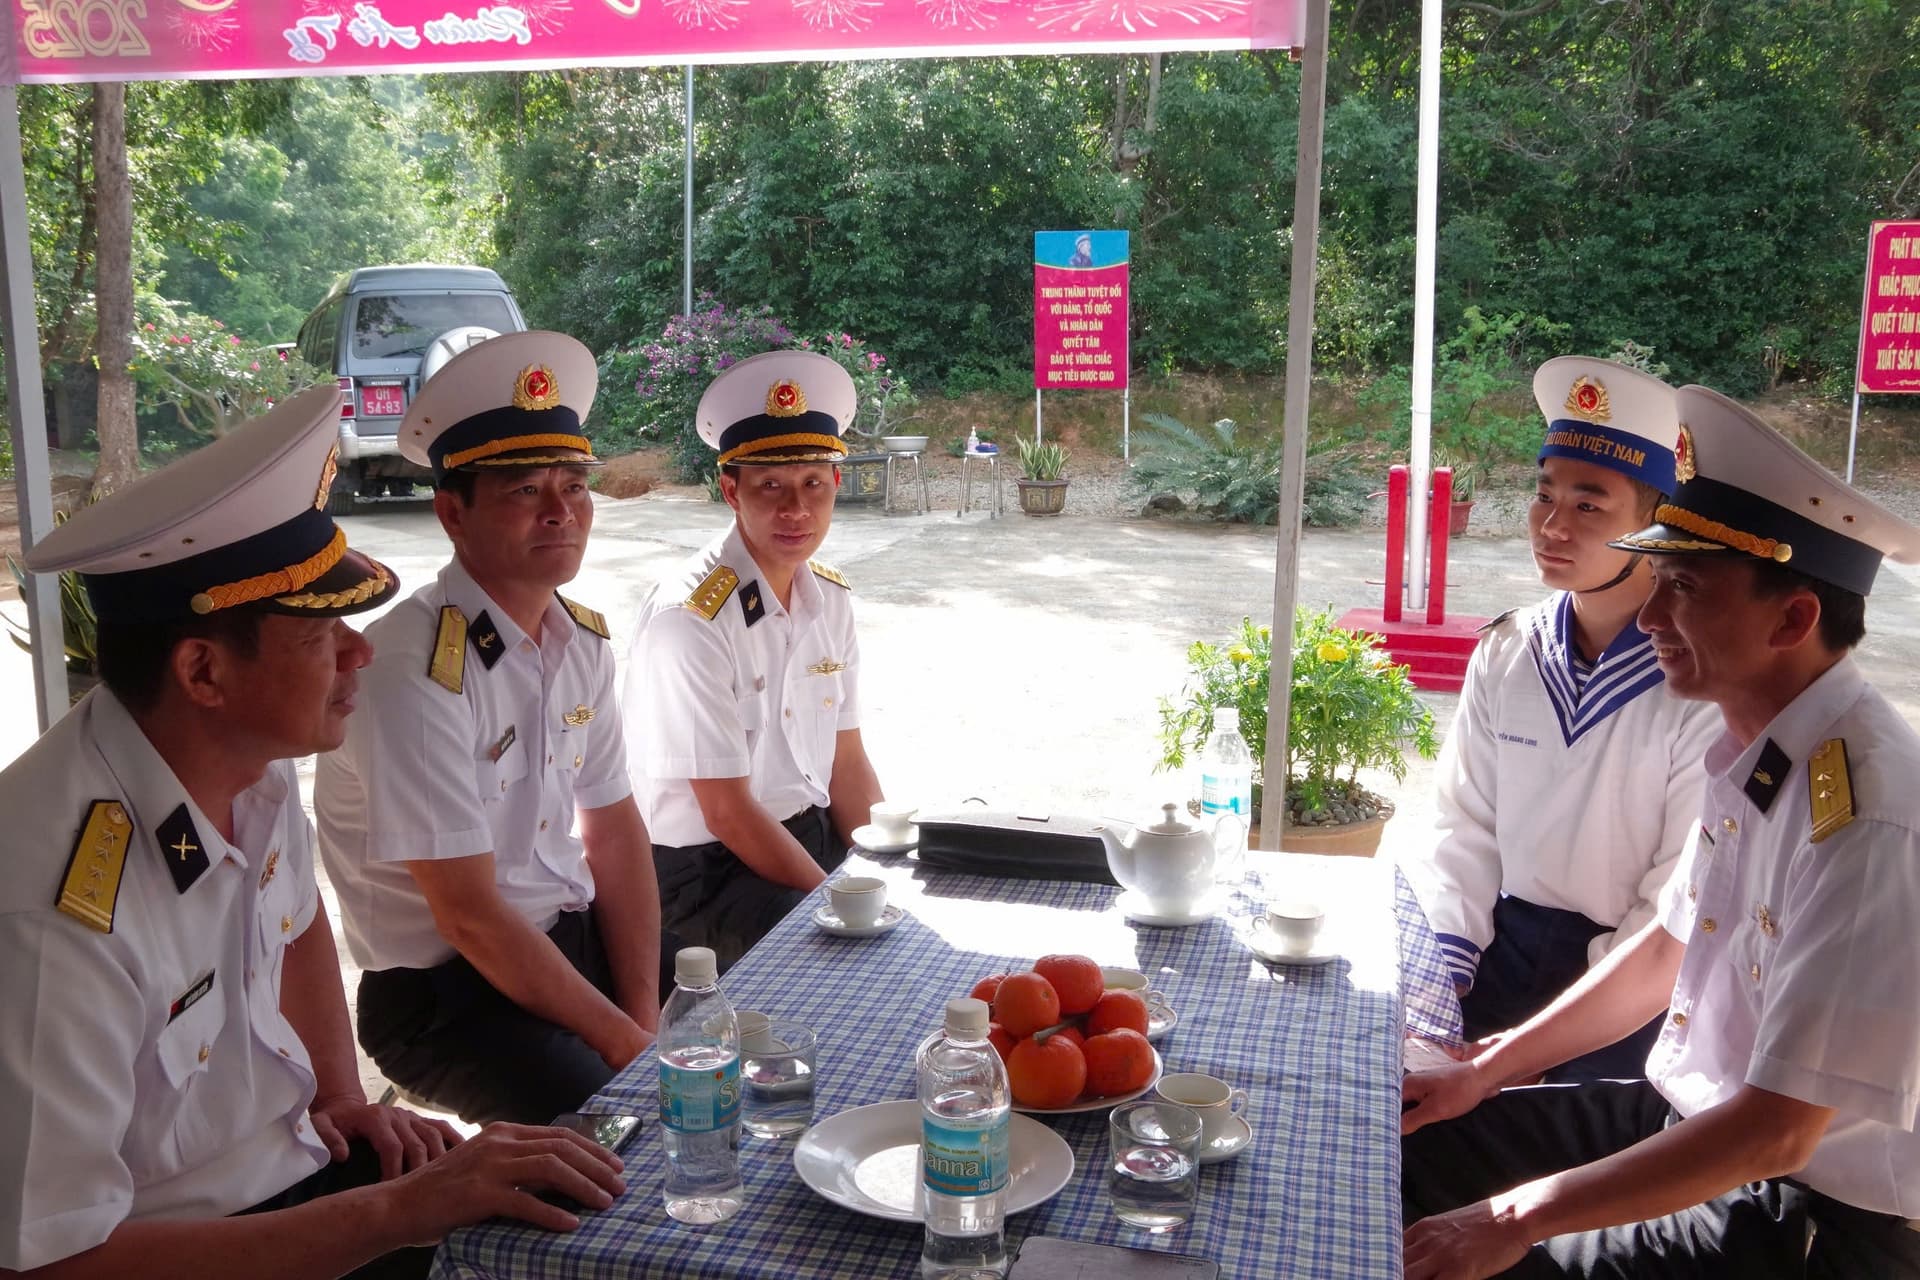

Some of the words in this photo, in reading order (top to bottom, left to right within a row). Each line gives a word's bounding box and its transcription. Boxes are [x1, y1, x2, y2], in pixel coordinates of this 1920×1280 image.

[1889, 231, 1911, 259] PHÁT
[1041, 287, 1063, 298] TRUNG
[1064, 284, 1086, 298] THÀNH
[1087, 284, 1108, 299] TUYỆT
[1109, 283, 1122, 298] ĐỐI
[1878, 265, 1900, 297] KHẮC
[1094, 300, 1113, 316] QUỐC
[1059, 318, 1069, 331] VÀ
[1089, 318, 1103, 331] DÂN
[1871, 303, 1898, 336] QUYẾT
[1898, 306, 1916, 333] TÂM
[1062, 334, 1084, 350] QUYẾT
[1084, 335, 1100, 348] TÂM
[1094, 350, 1112, 365] CHẮC
[1876, 341, 1898, 370] XUẤT
[1897, 340, 1914, 370] SẮC
[1063, 368, 1079, 382] TIÊU
[1099, 370, 1115, 382] GIAO
[1583, 434, 1614, 456] VIỆT
[1613, 444, 1646, 468] NAM
[924, 1152, 980, 1177] anna
